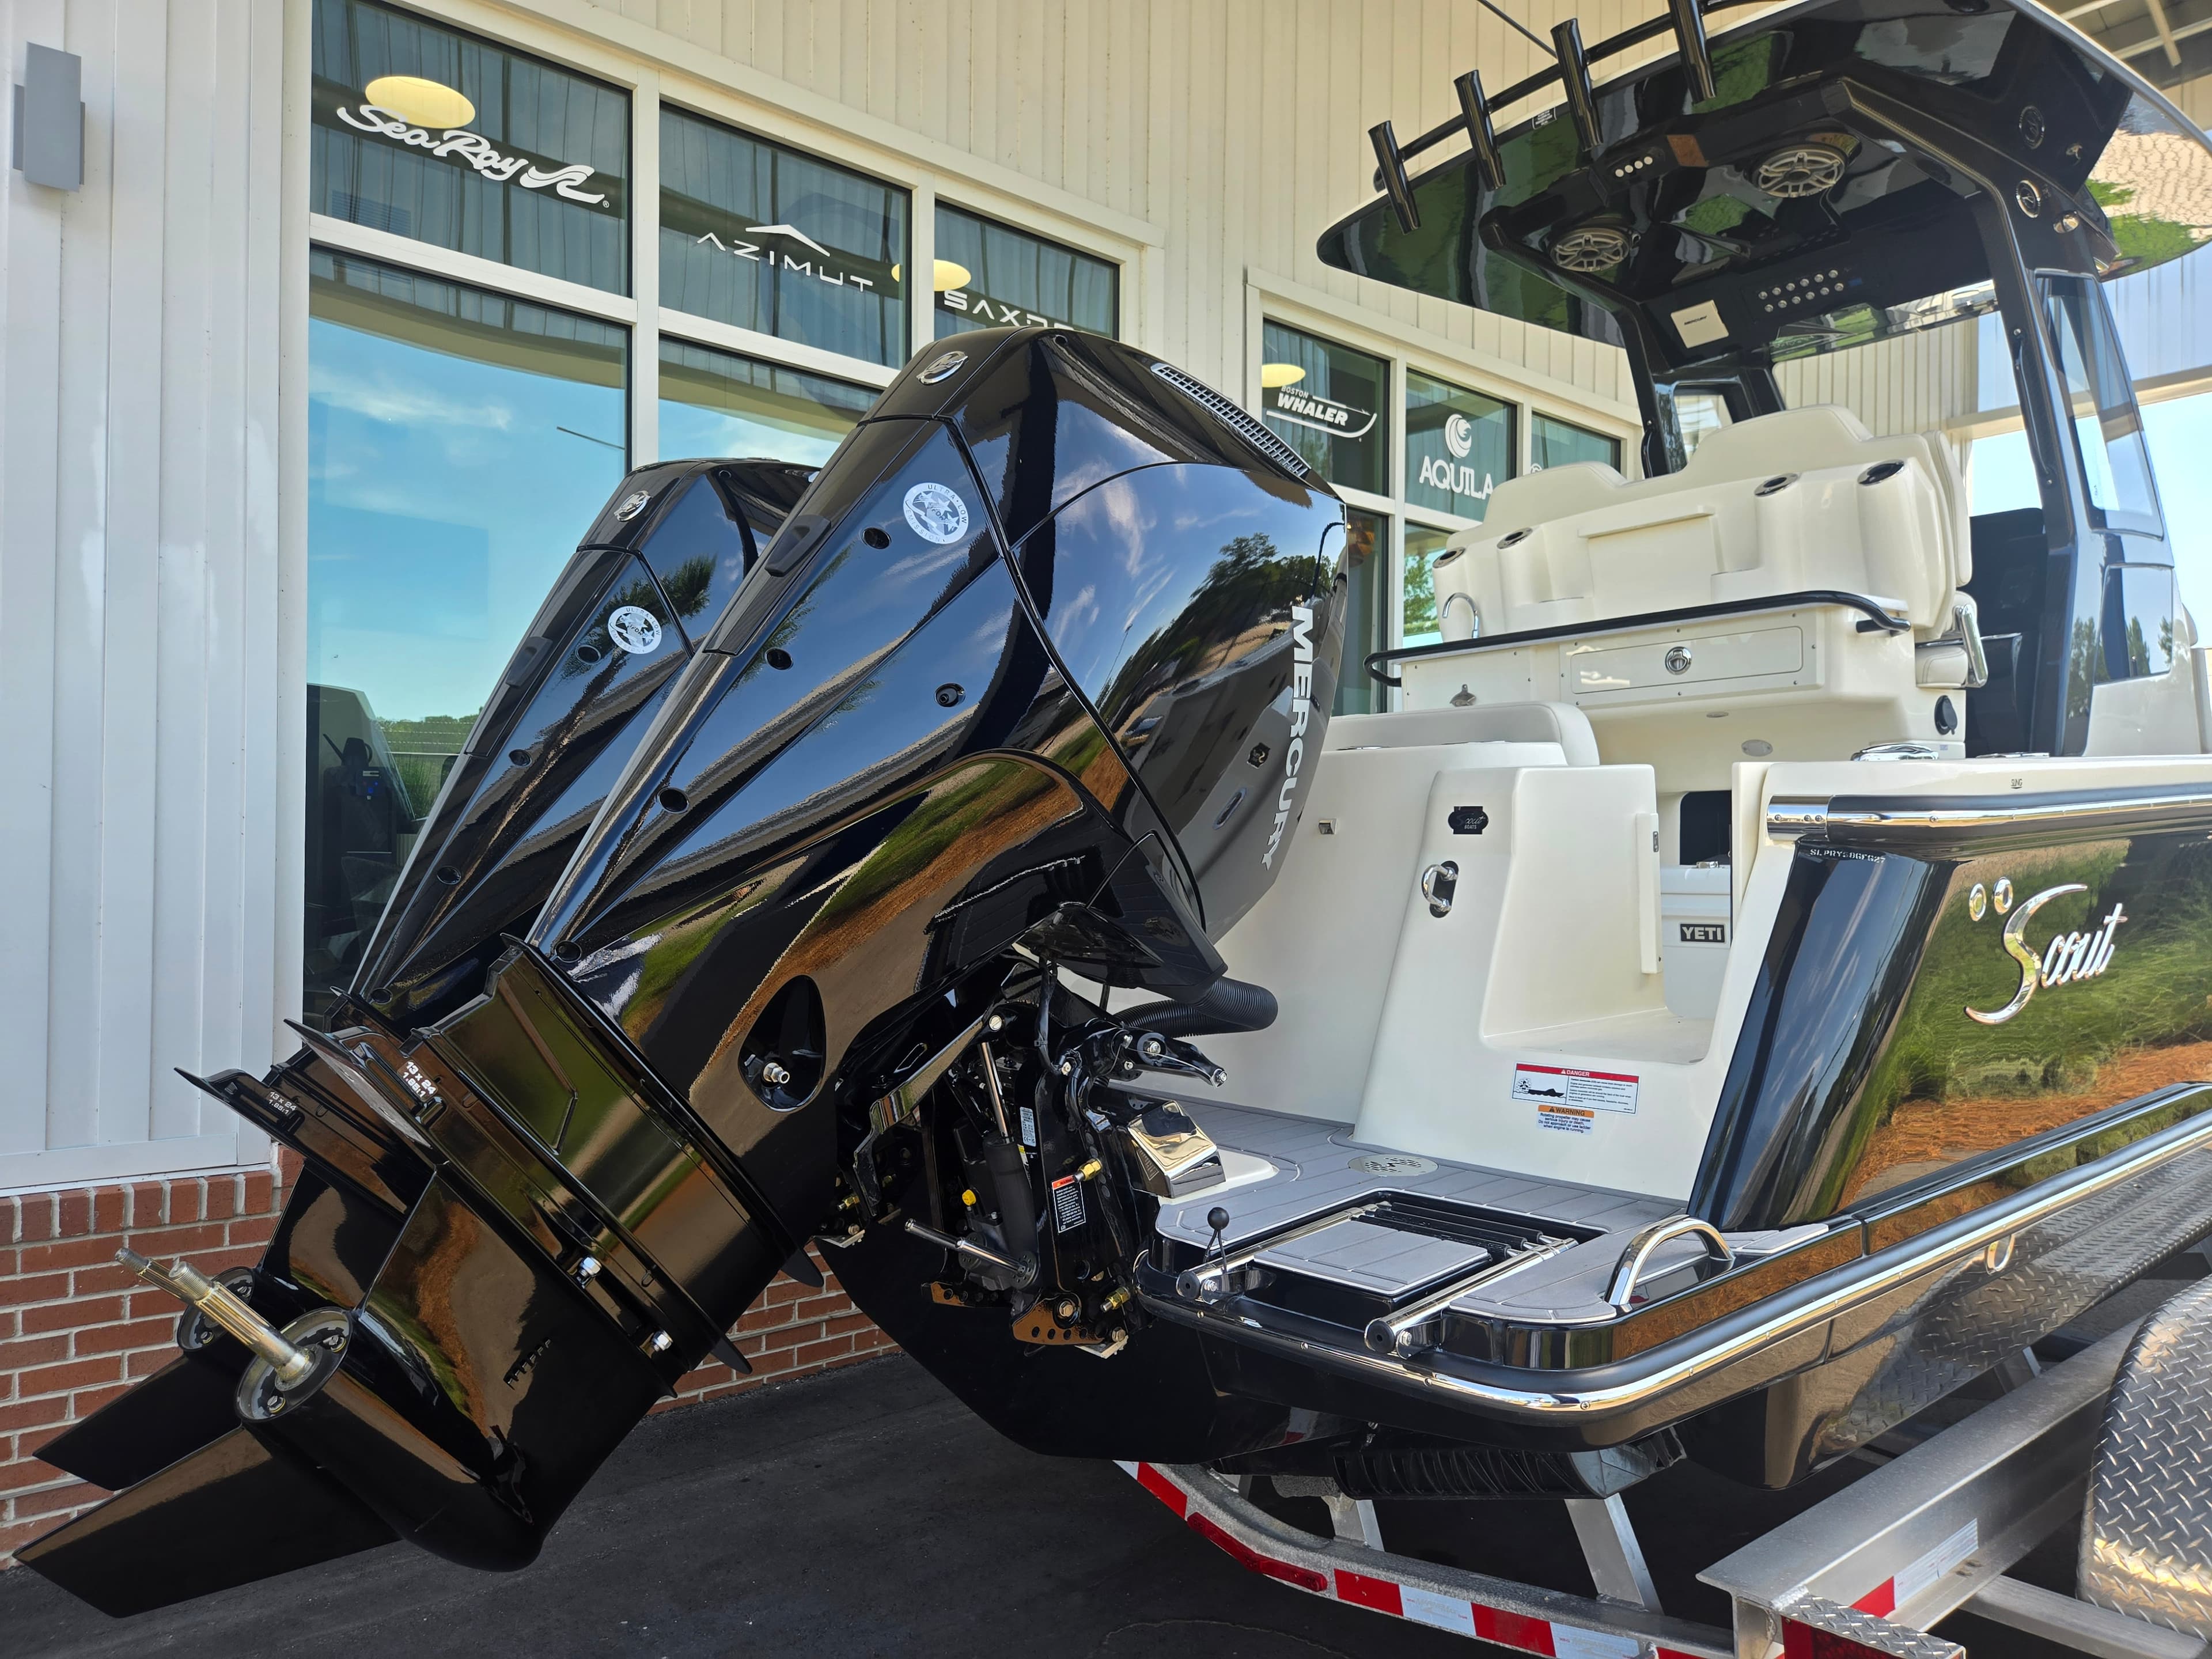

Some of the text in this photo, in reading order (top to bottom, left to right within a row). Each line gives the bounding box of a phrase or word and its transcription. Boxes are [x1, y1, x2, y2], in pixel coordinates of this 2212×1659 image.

[337, 104, 529, 181] Sea Ray
[697, 232, 873, 292] AZIMUT
[1281, 385, 1309, 398] BOSTON
[1277, 392, 1349, 426] WHALER
[1419, 455, 1493, 500] AQUILA
[957, 504, 967, 524] LOW
[1261, 605, 1314, 870] MERCURY
[1681, 926, 1722, 940] YETI
[1963, 883, 2128, 1025] Scout
[406, 1061, 419, 1074] 13
[421, 1079, 437, 1094] 24
[270, 1092, 280, 1100] 13
[285, 1101, 297, 1111] 24
[1556, 1107, 1585, 1116] WARNING
